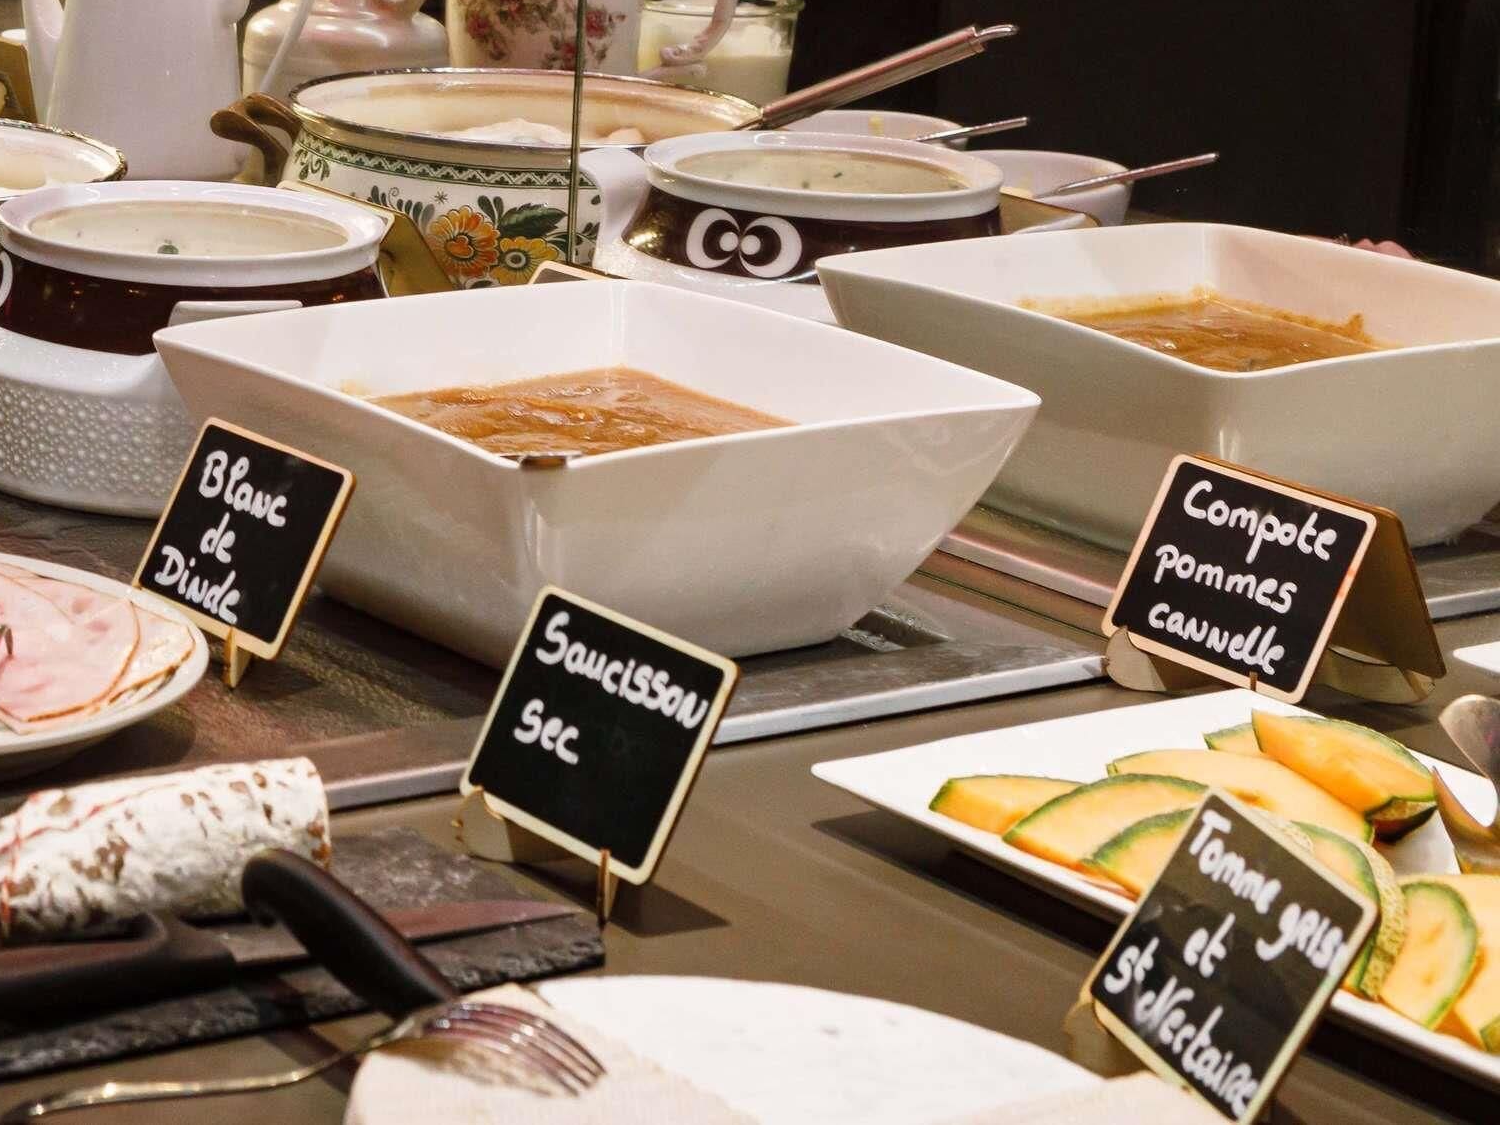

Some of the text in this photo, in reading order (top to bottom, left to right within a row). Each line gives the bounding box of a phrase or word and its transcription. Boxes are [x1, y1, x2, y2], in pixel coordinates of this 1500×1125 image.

[199, 450, 287, 528] Blanc
[1183, 480, 1337, 564] Compote
[200, 512, 236, 564] de
[154, 545, 241, 625] Dinde
[1154, 544, 1298, 614] pommes
[536, 611, 709, 729] Saucisson
[1148, 603, 1285, 675] cannelle
[1189, 809, 1282, 914] Tomme
[1183, 913, 1236, 977] et
